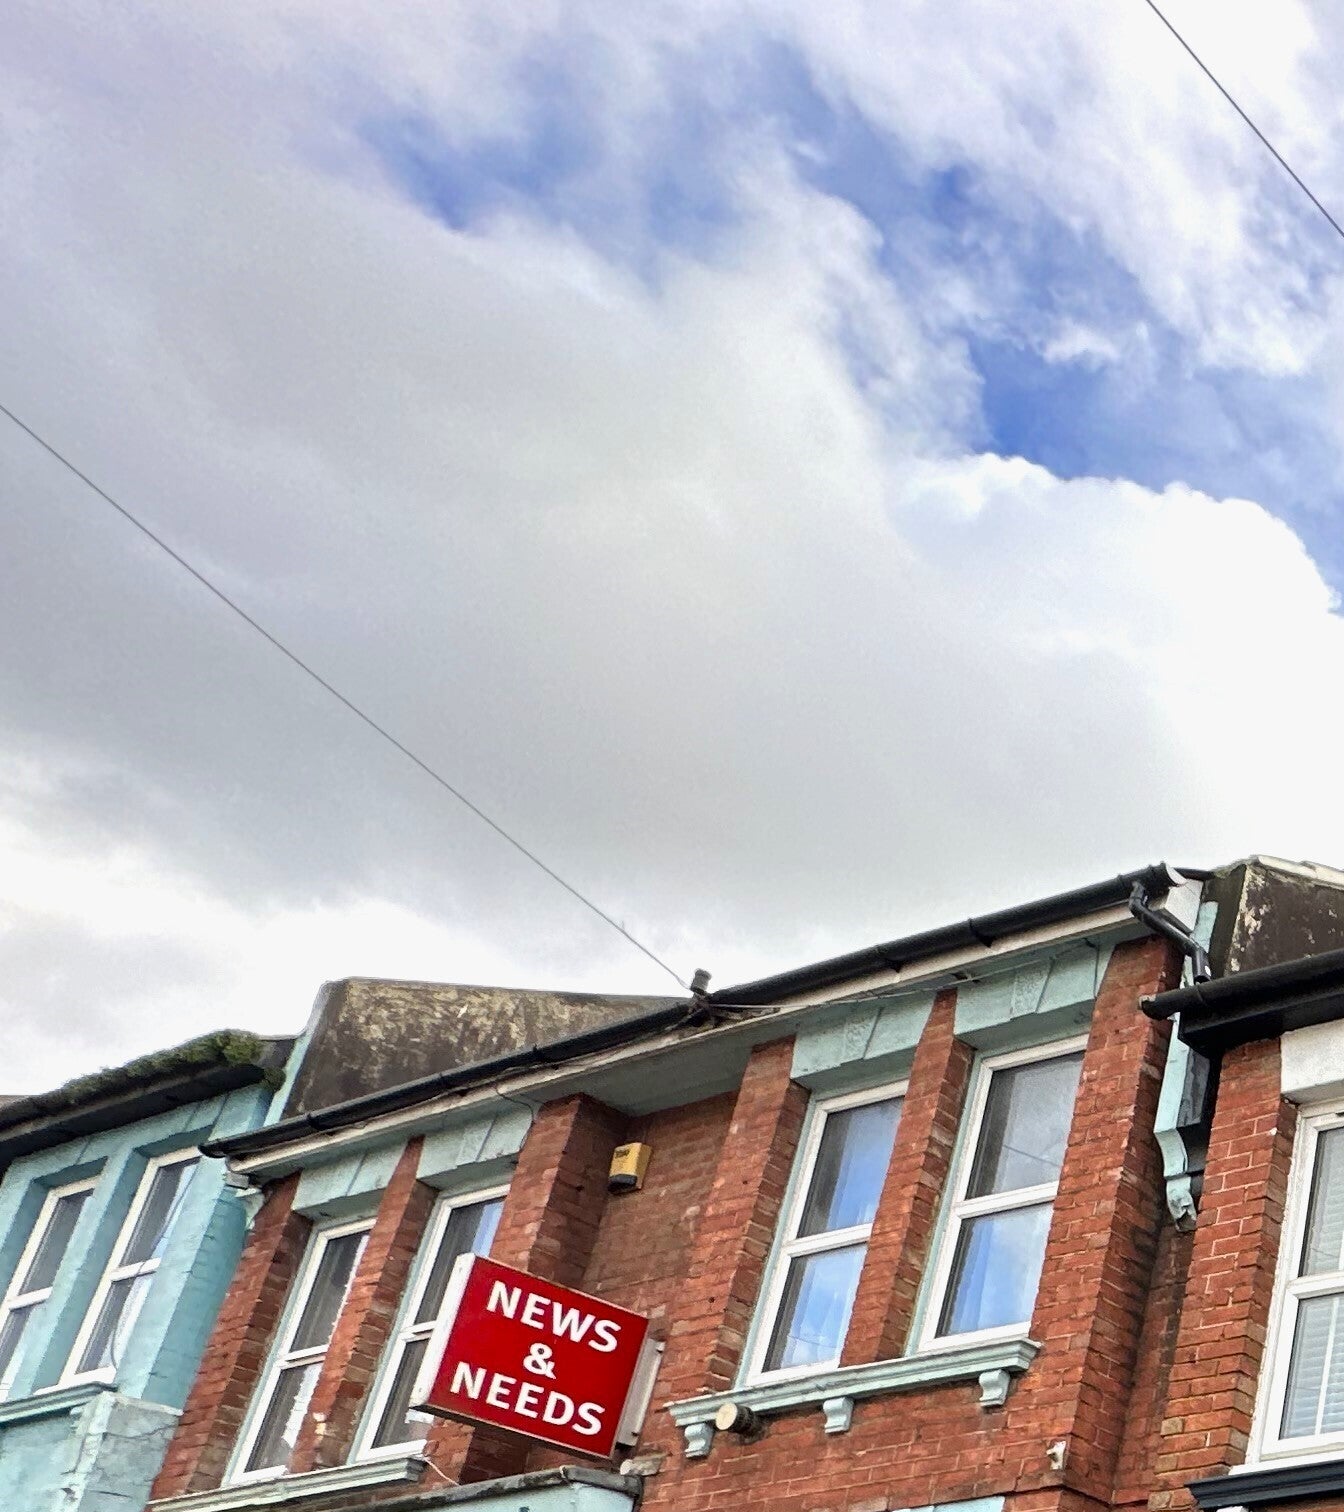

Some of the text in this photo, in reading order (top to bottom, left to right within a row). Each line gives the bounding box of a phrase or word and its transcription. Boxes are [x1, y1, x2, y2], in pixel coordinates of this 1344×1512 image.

[487, 1280, 622, 1353] NEWS
[522, 1342, 557, 1380] &
[450, 1361, 606, 1436] NEEDS
